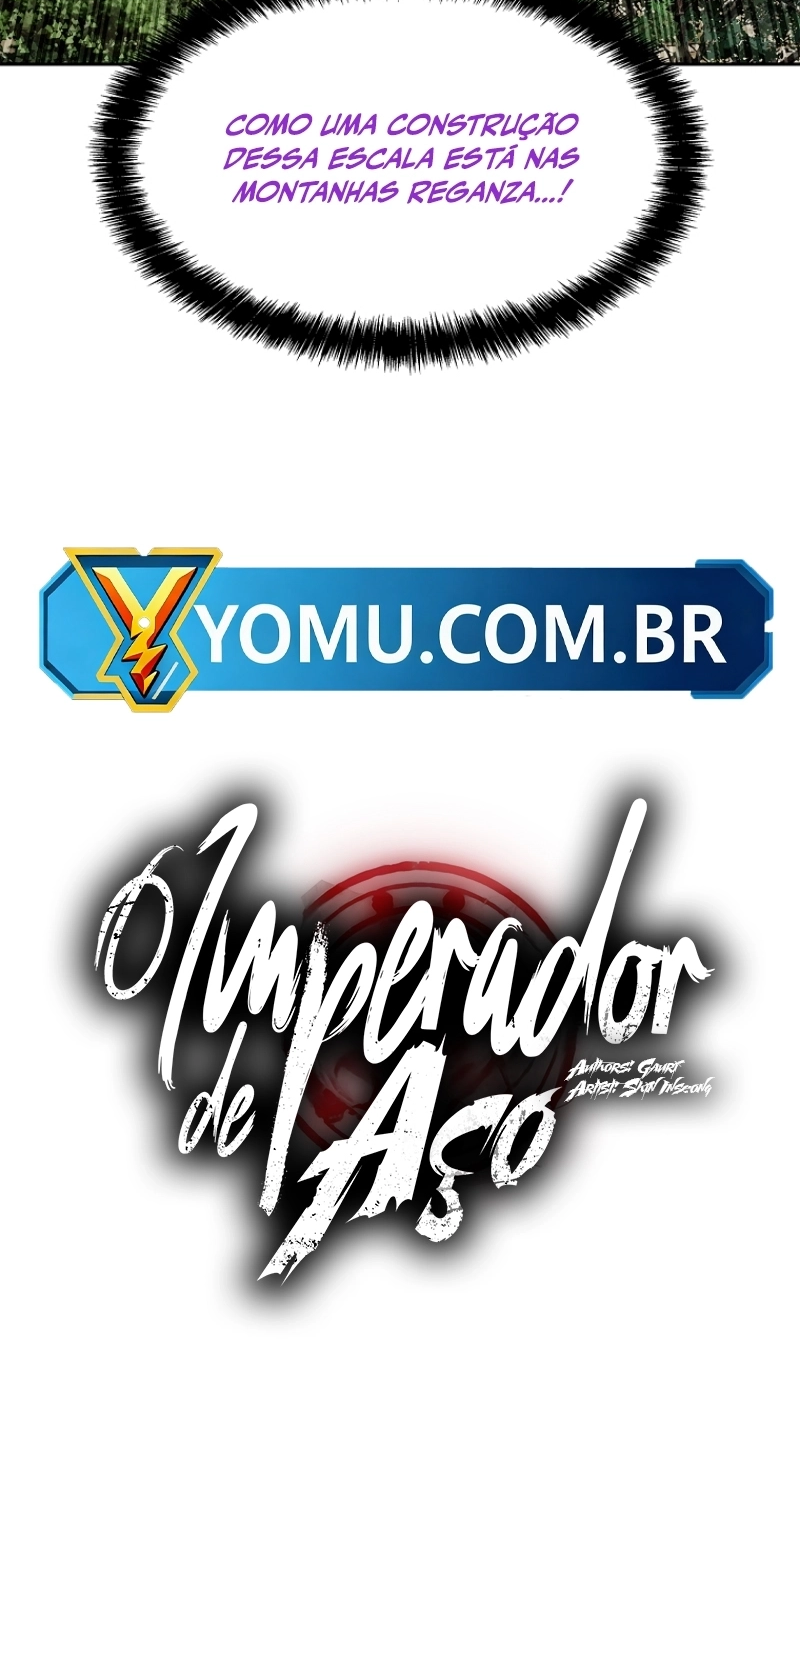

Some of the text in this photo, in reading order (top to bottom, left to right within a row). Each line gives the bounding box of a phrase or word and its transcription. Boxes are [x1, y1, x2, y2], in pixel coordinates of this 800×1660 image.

[225, 112, 580, 141] COMO UMA CONSTRUÇÃO
[223, 144, 581, 171] DESSA ESCALA ESTÁ NAS
[231, 179, 575, 204] MONTANHAS REGANZA...!
[95, 798, 716, 1216] O Imperador
[178, 1021, 562, 1287] de Aço
